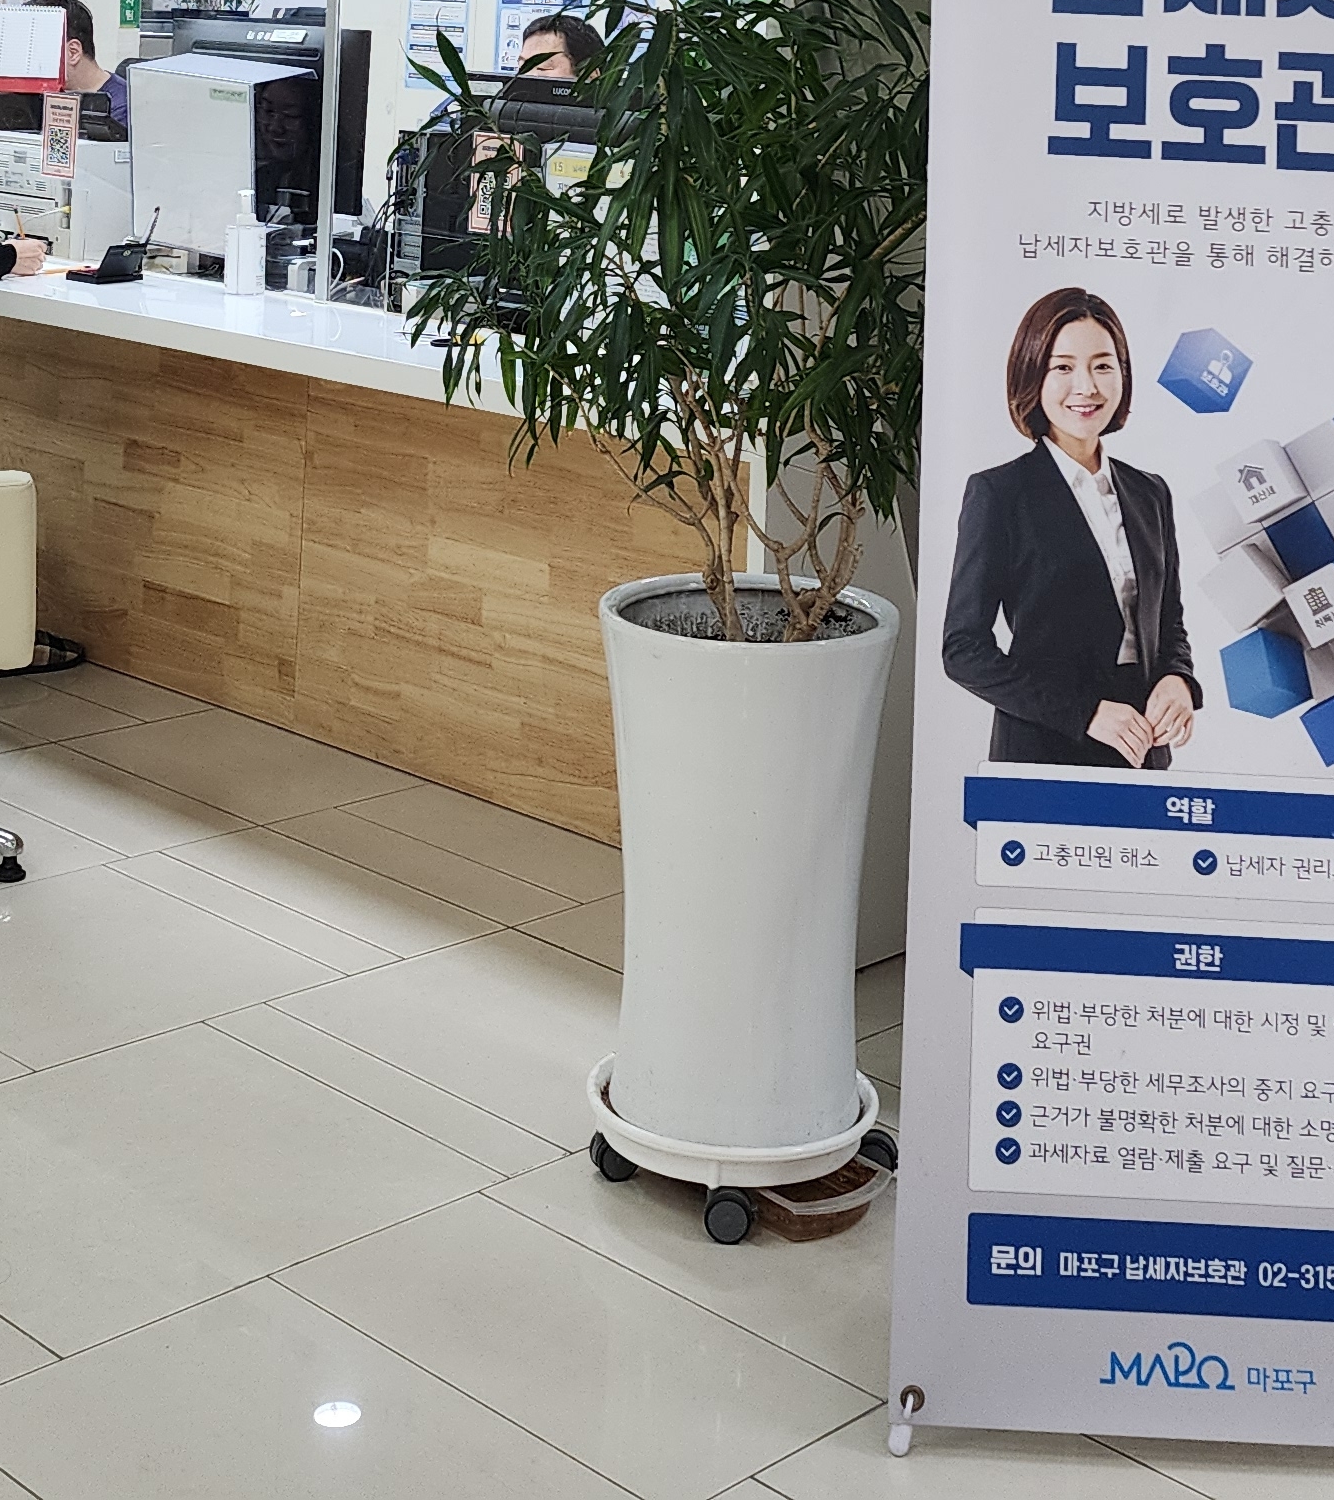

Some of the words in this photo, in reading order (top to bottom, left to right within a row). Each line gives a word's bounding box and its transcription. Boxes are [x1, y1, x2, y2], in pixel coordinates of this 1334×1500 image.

[1087, 199, 1186, 228] 지방세로
[1198, 204, 1273, 234] 발생한
[1017, 232, 1196, 266] 납세자보호관을
[1205, 243, 1256, 270] 통해
[1249, 484, 1277, 506] 재산세
[1165, 796, 1216, 827] 역할
[1033, 842, 1113, 870] 고충민원
[1119, 845, 1160, 870] 해소
[1225, 854, 1286, 879] 납세자
[1173, 943, 1224, 975] 권한
[1031, 999, 1140, 1029] 위법·부당한
[1146, 1005, 1207, 1030] 처분에
[1213, 1008, 1254, 1033] 대한
[1260, 1010, 1301, 1036] 시정
[1306, 1014, 1328, 1038] 및
[1031, 1031, 1092, 1057] 요구권
[1029, 1066, 1140, 1095] 위법·부당한
[1145, 1071, 1247, 1100] 세무조사의
[1252, 1077, 1294, 1101] 중지
[1029, 1103, 1091, 1130] 근거가
[1097, 1108, 1179, 1135] 불명확한
[1184, 1111, 1245, 1137] 처분에
[1251, 1115, 1293, 1140] 대한
[1028, 1140, 1111, 1167] 과세자료
[1116, 1146, 1207, 1174] 열람·제출
[1212, 1151, 1253, 1175] 요구
[1259, 1153, 1280, 1177] 및
[990, 1244, 1043, 1277] 문의
[1059, 1251, 1120, 1280] 마포구
[1125, 1255, 1247, 1287] 납세자보호관
[1099, 1341, 1236, 1392] MAPO
[1247, 1365, 1317, 1395] 마포구
